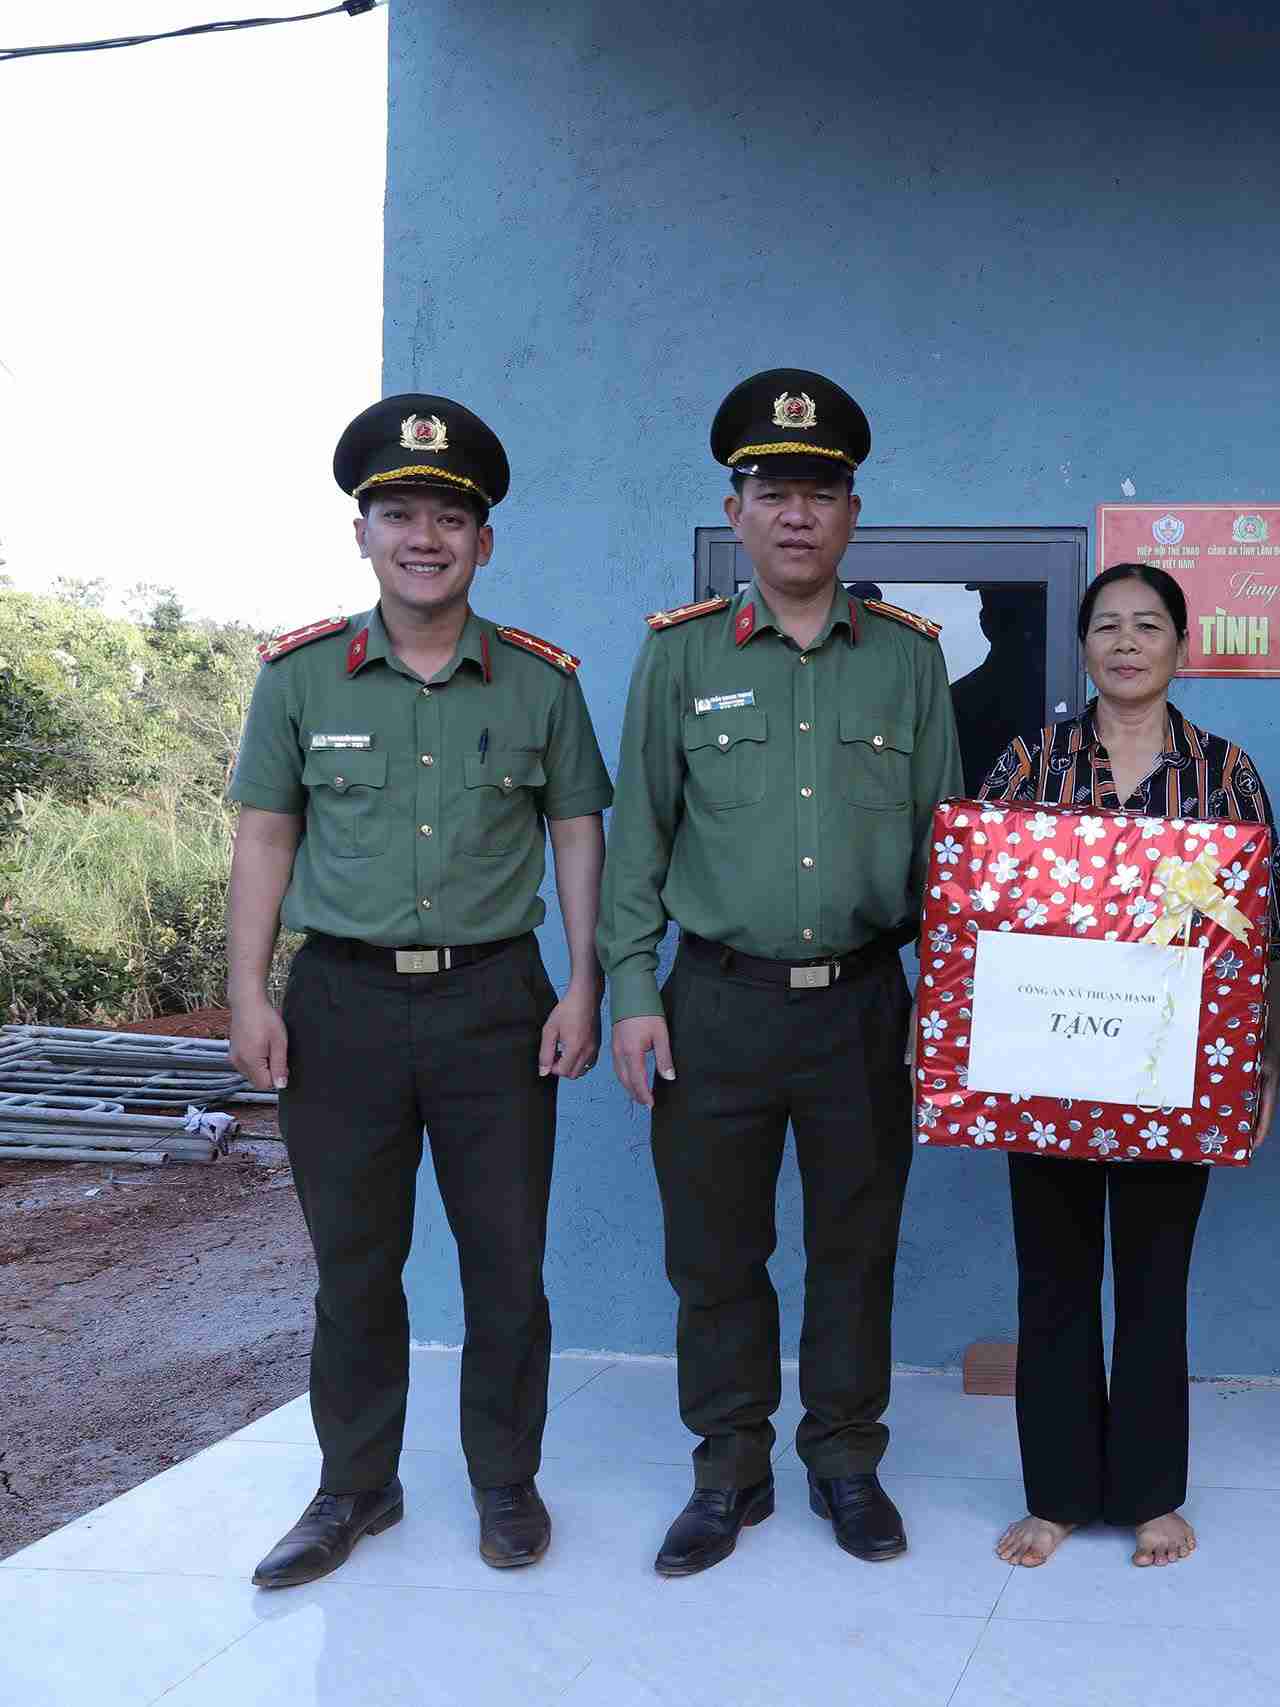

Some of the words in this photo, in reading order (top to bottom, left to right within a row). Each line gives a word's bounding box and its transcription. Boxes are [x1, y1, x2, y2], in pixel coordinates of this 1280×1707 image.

[1199, 606, 1269, 656] TÌNH
[1017, 984, 1048, 997] CÔNG
[1050, 986, 1066, 997] AN
[1050, 1011, 1123, 1039] TẶNG
